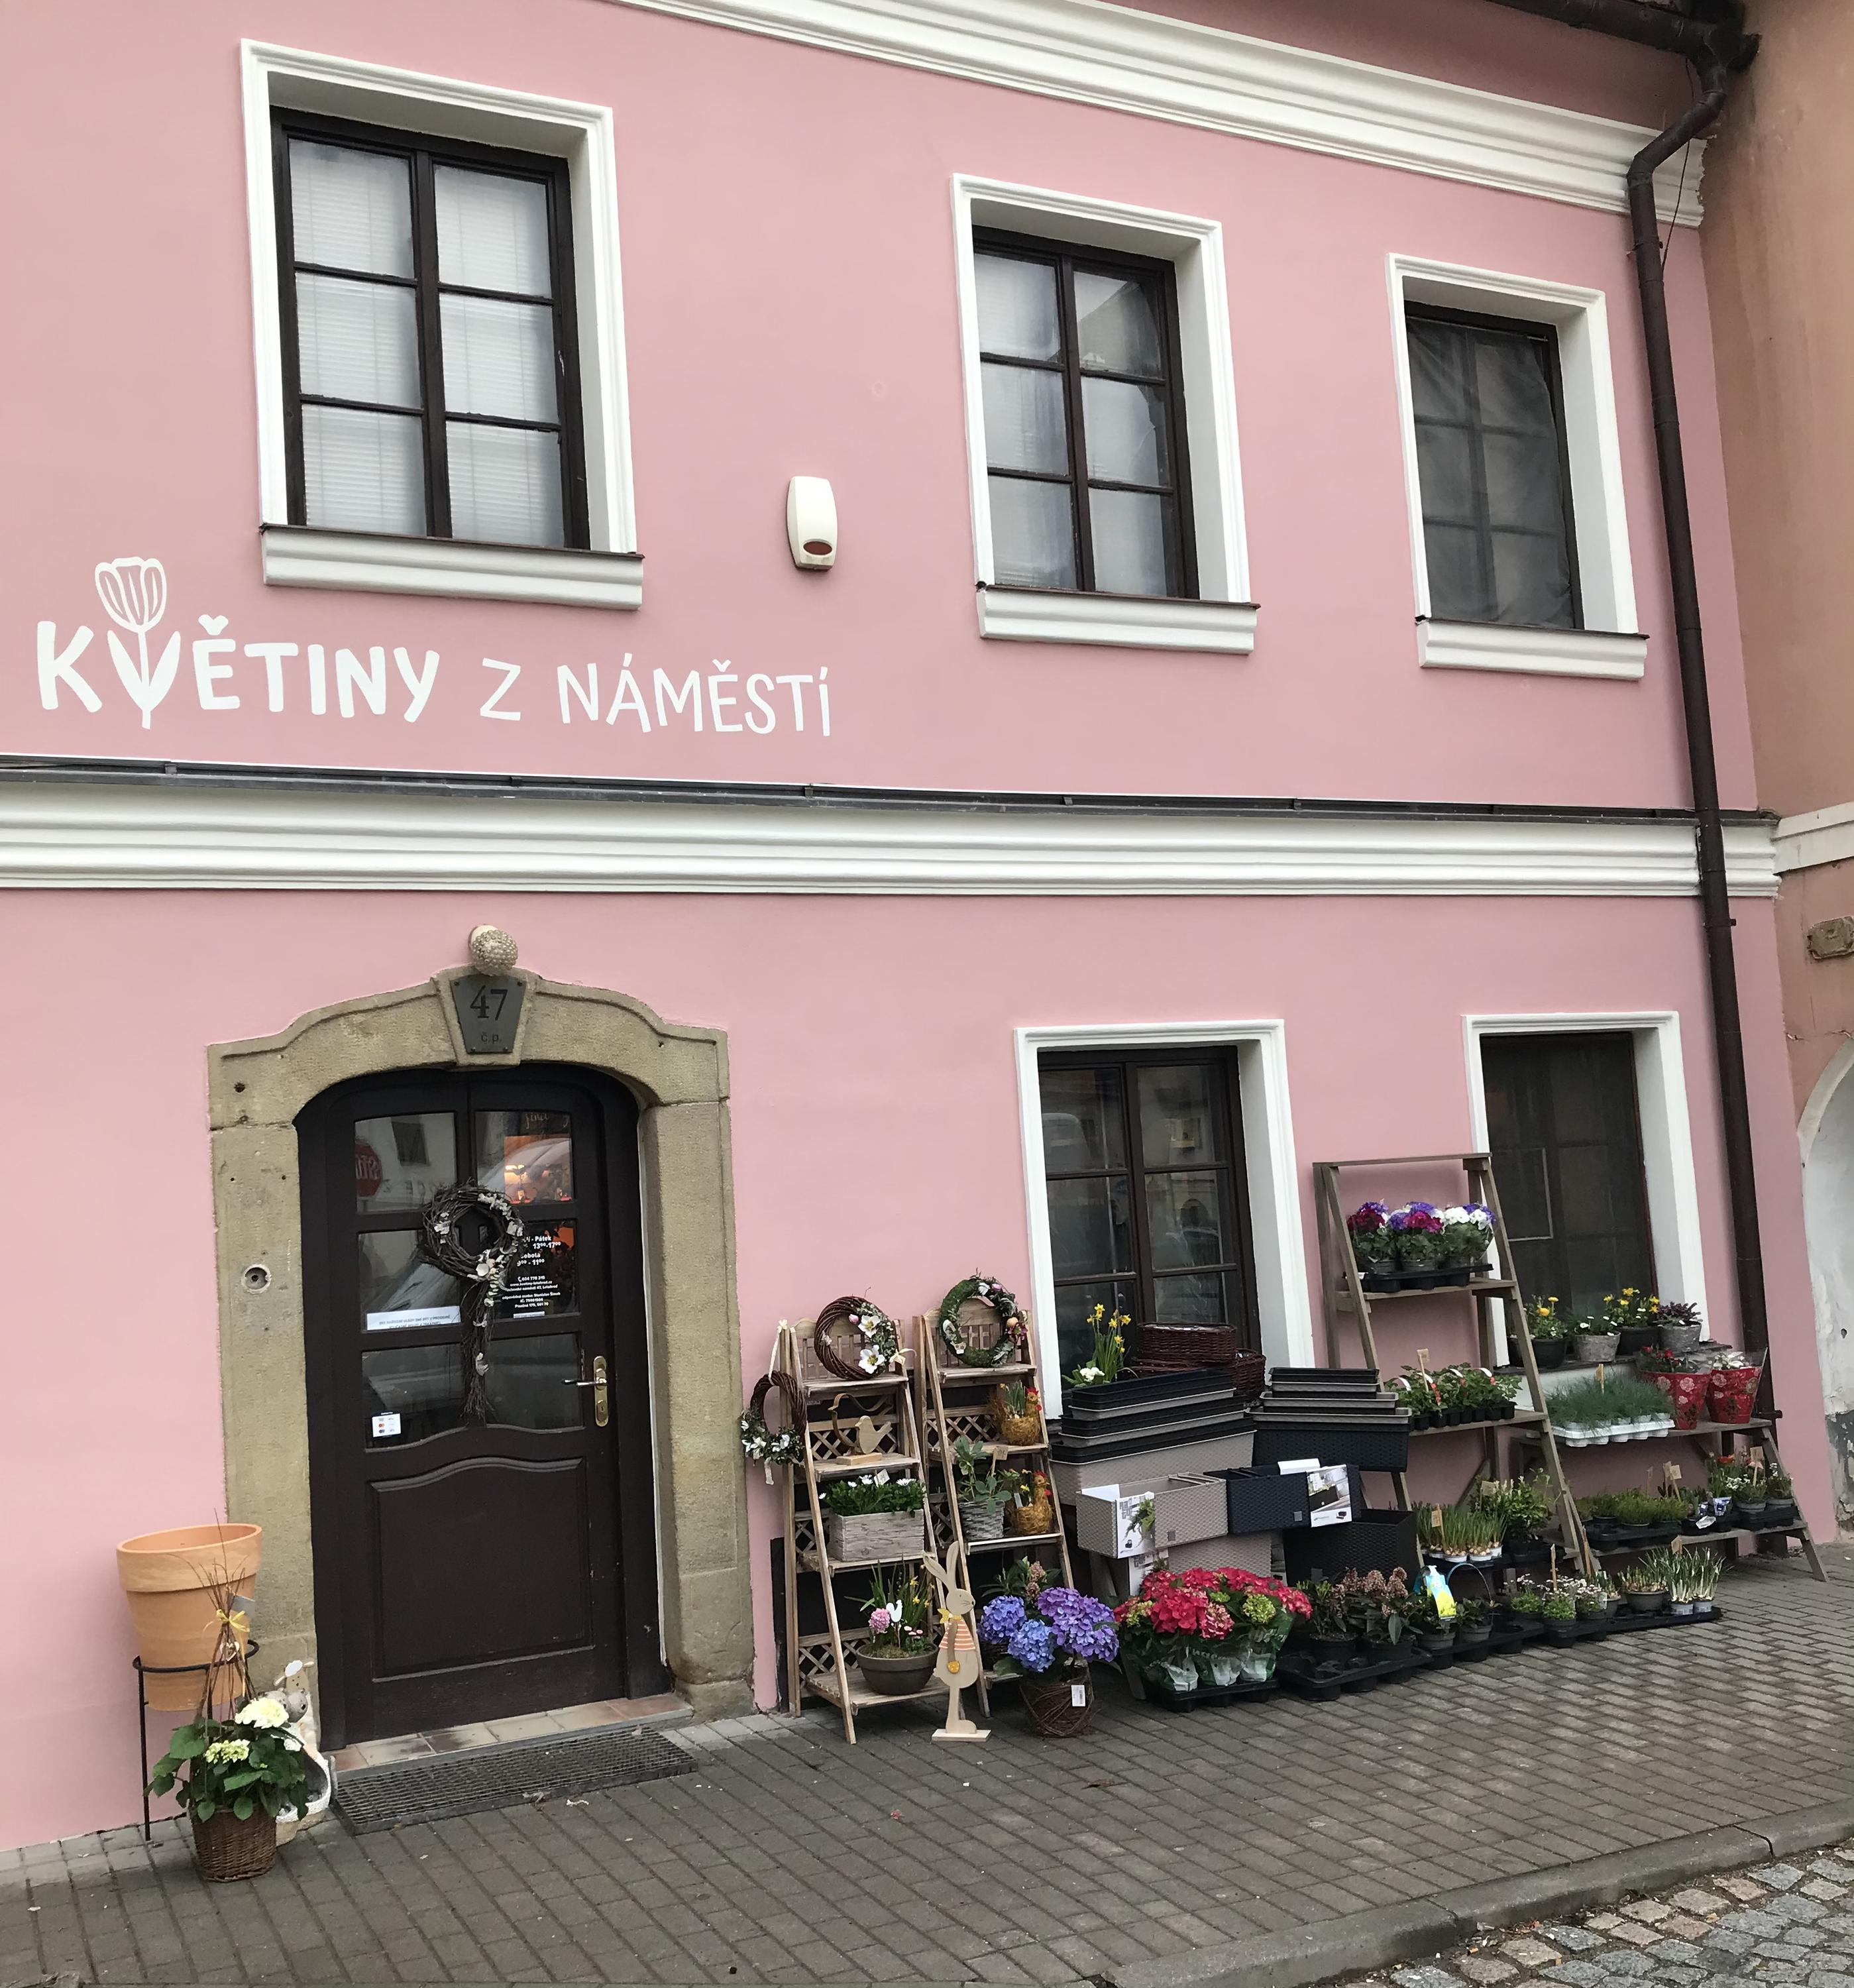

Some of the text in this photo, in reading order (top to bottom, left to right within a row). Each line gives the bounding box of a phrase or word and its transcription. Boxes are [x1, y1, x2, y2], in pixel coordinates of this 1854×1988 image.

[37, 614, 830, 736] KVĚTINY Z NÁMĚSTÍ
[470, 985, 508, 1021] 47
